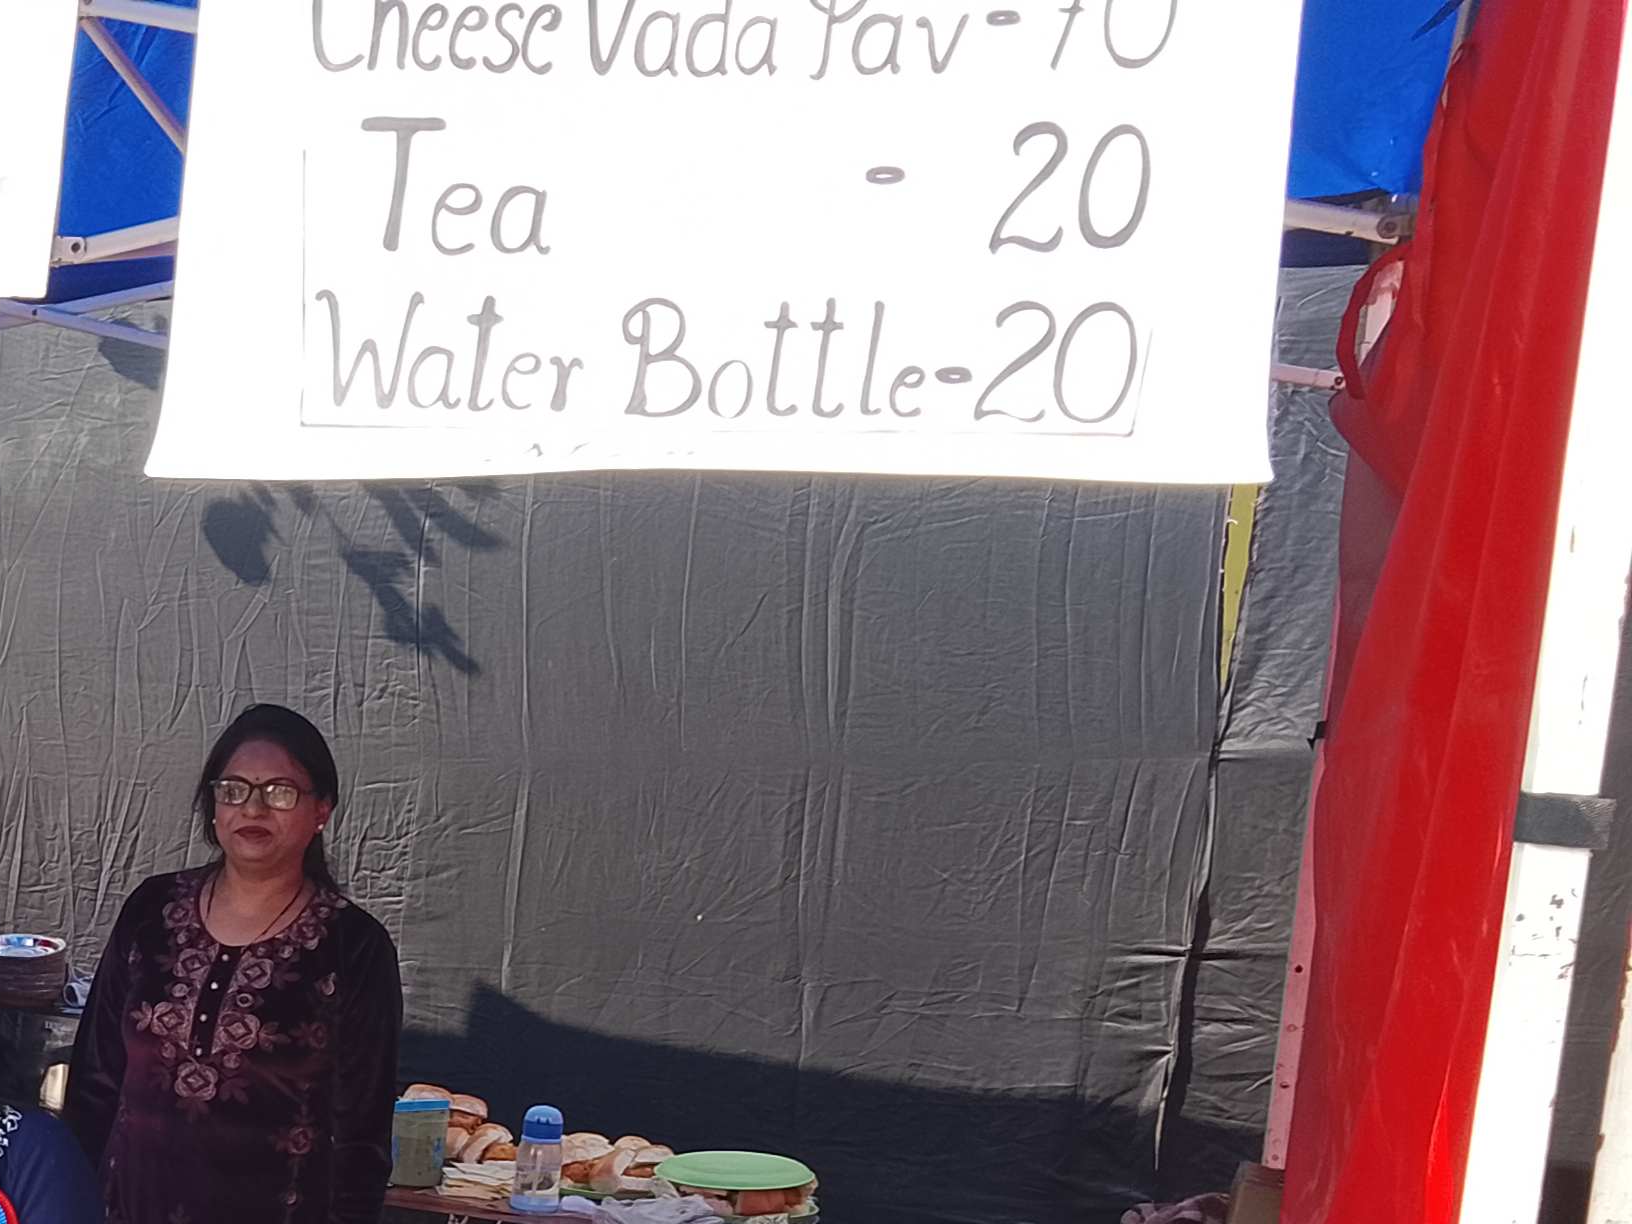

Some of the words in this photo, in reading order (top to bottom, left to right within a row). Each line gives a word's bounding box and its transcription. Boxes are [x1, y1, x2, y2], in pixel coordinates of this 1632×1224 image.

[312, 0, 563, 75] Cheese
[588, 0, 777, 79] Vada
[360, 116, 552, 256] Tea
[988, 121, 1152, 254] 20
[314, 289, 585, 412] Water
